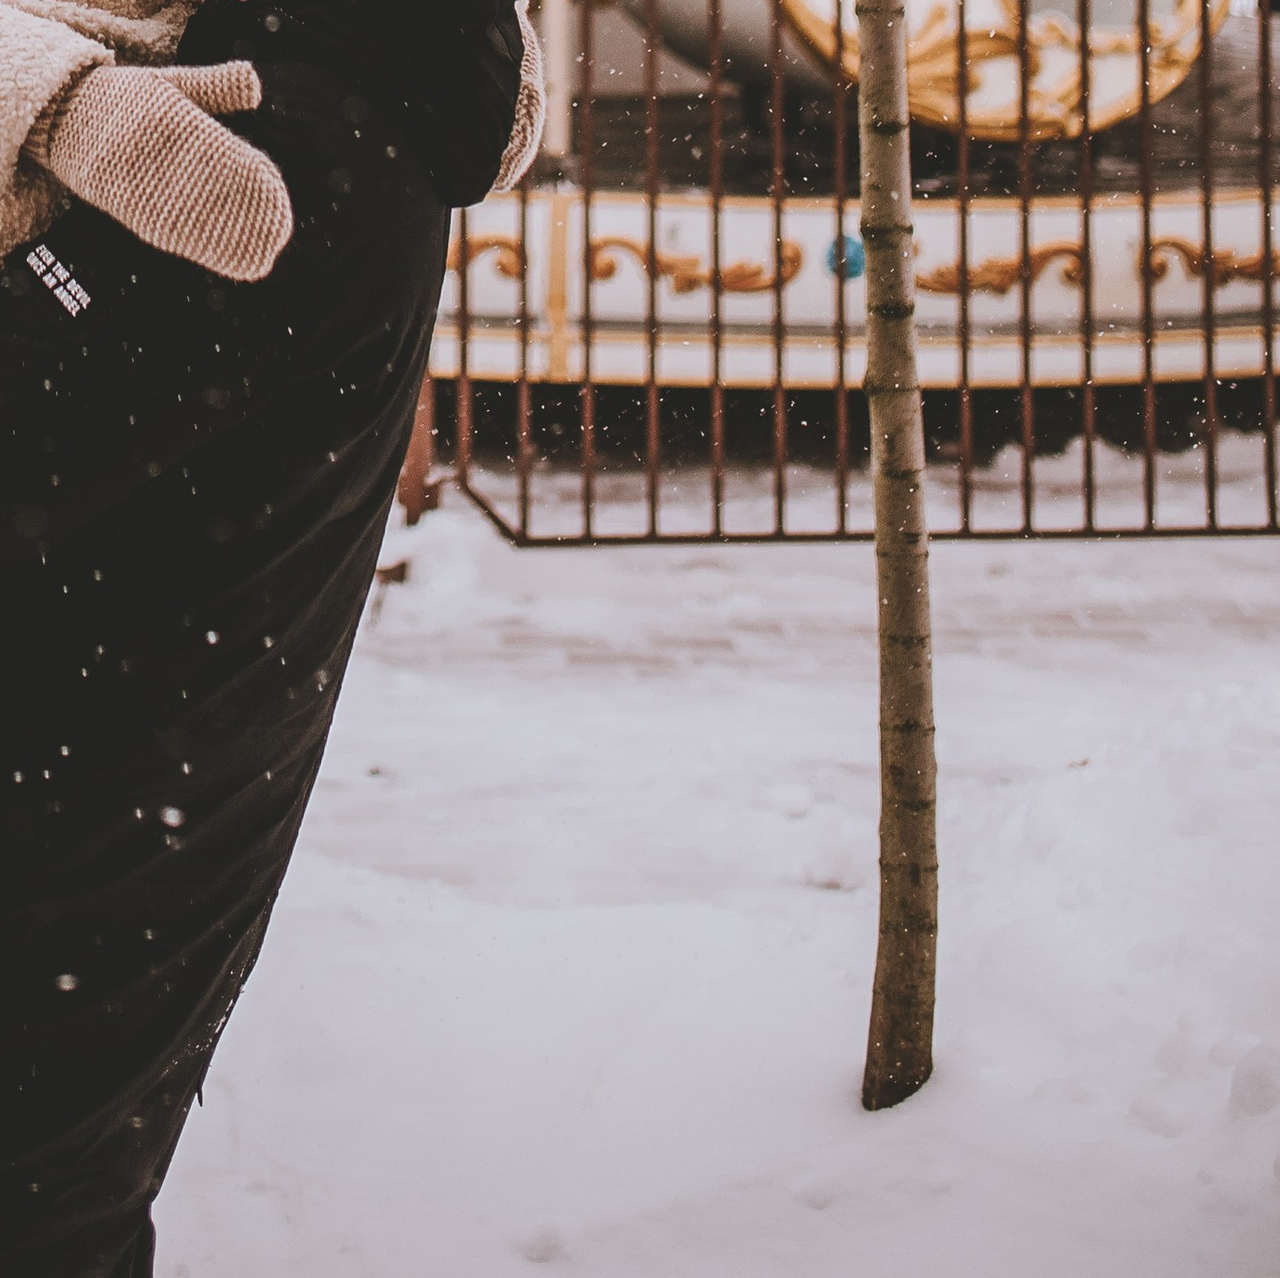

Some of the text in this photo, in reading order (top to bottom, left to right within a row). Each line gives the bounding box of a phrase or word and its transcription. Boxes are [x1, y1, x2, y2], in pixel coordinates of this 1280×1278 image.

[26, 251, 80, 317] ONCE AN ANGEL
[35, 244, 91, 309] EVEN THE DEVIL
